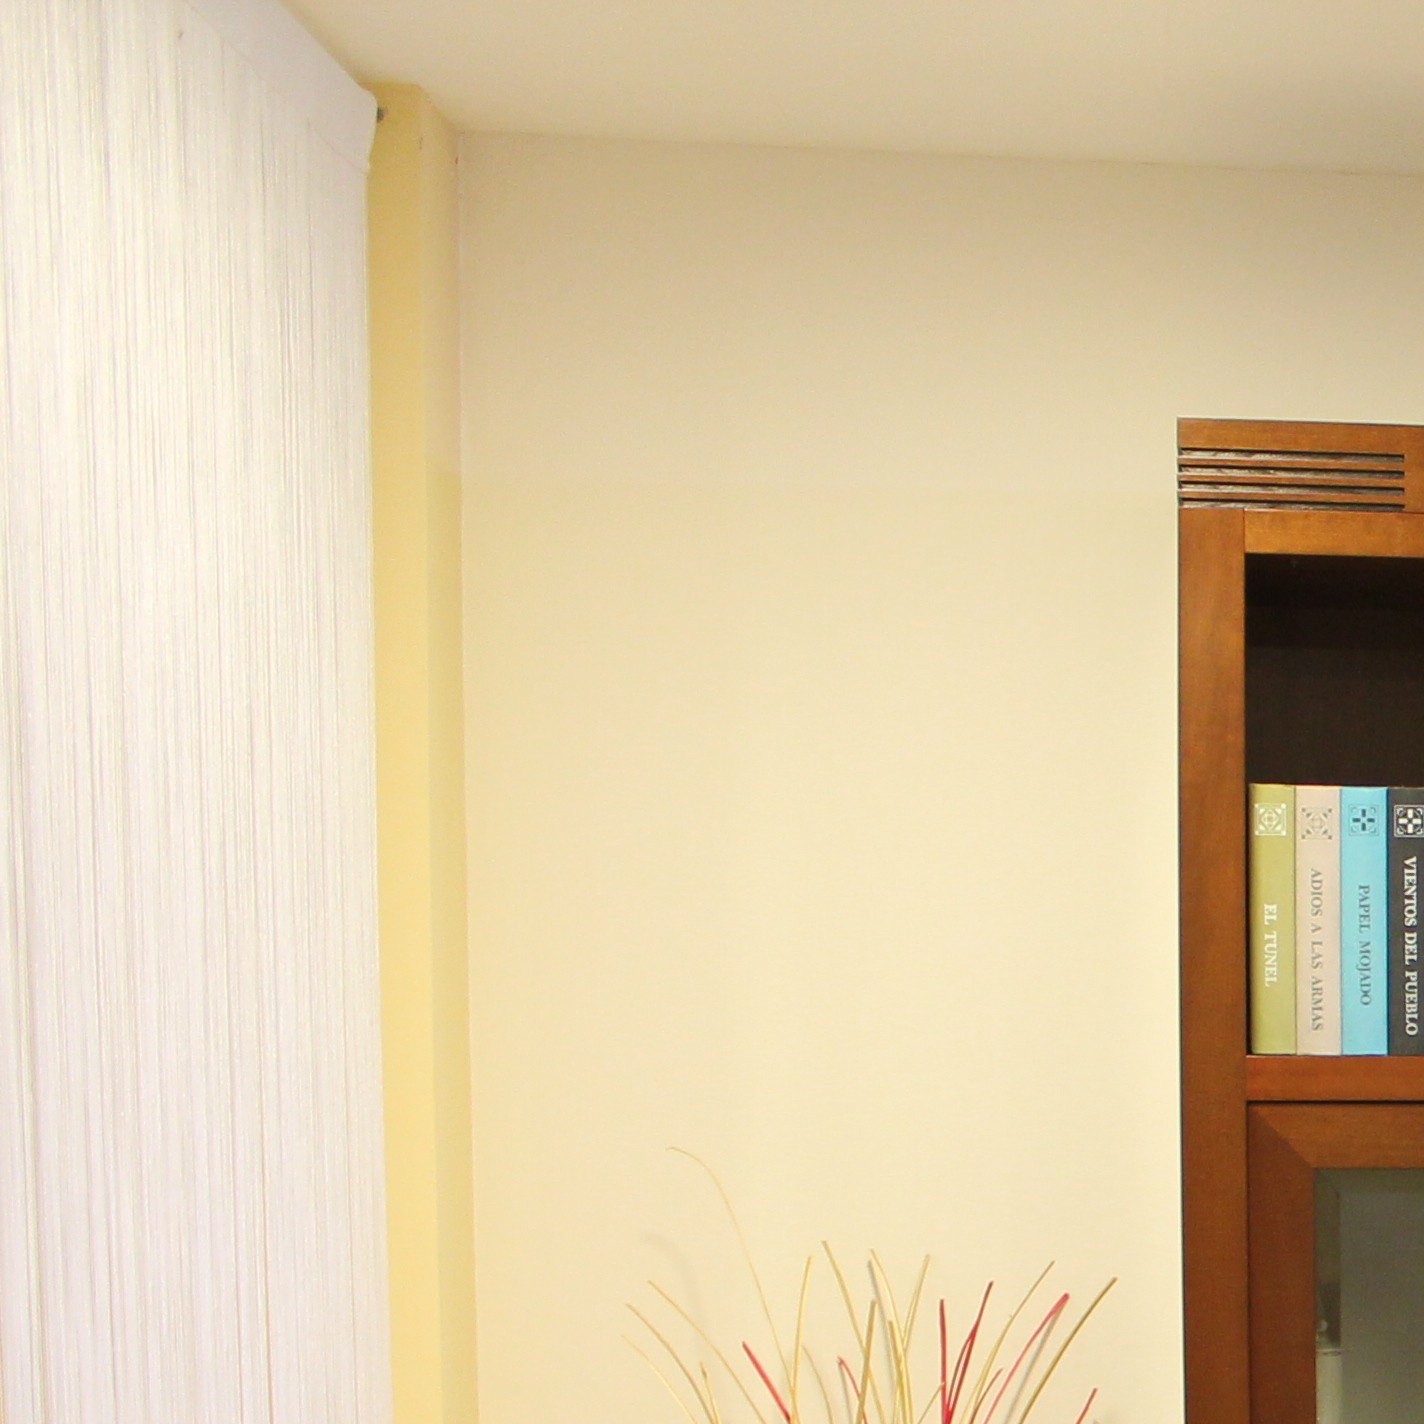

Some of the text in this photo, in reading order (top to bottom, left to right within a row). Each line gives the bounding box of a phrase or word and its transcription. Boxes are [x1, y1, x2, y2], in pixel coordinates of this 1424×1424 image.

[1263, 904, 1278, 987] EL TUNEL
[1310, 868, 1324, 1031] ADIOS A LAS ARMAS
[1356, 885, 1372, 1006] PAPEL MOJADO
[1403, 856, 1419, 1036] VIENTOS DEL PUEBLO
